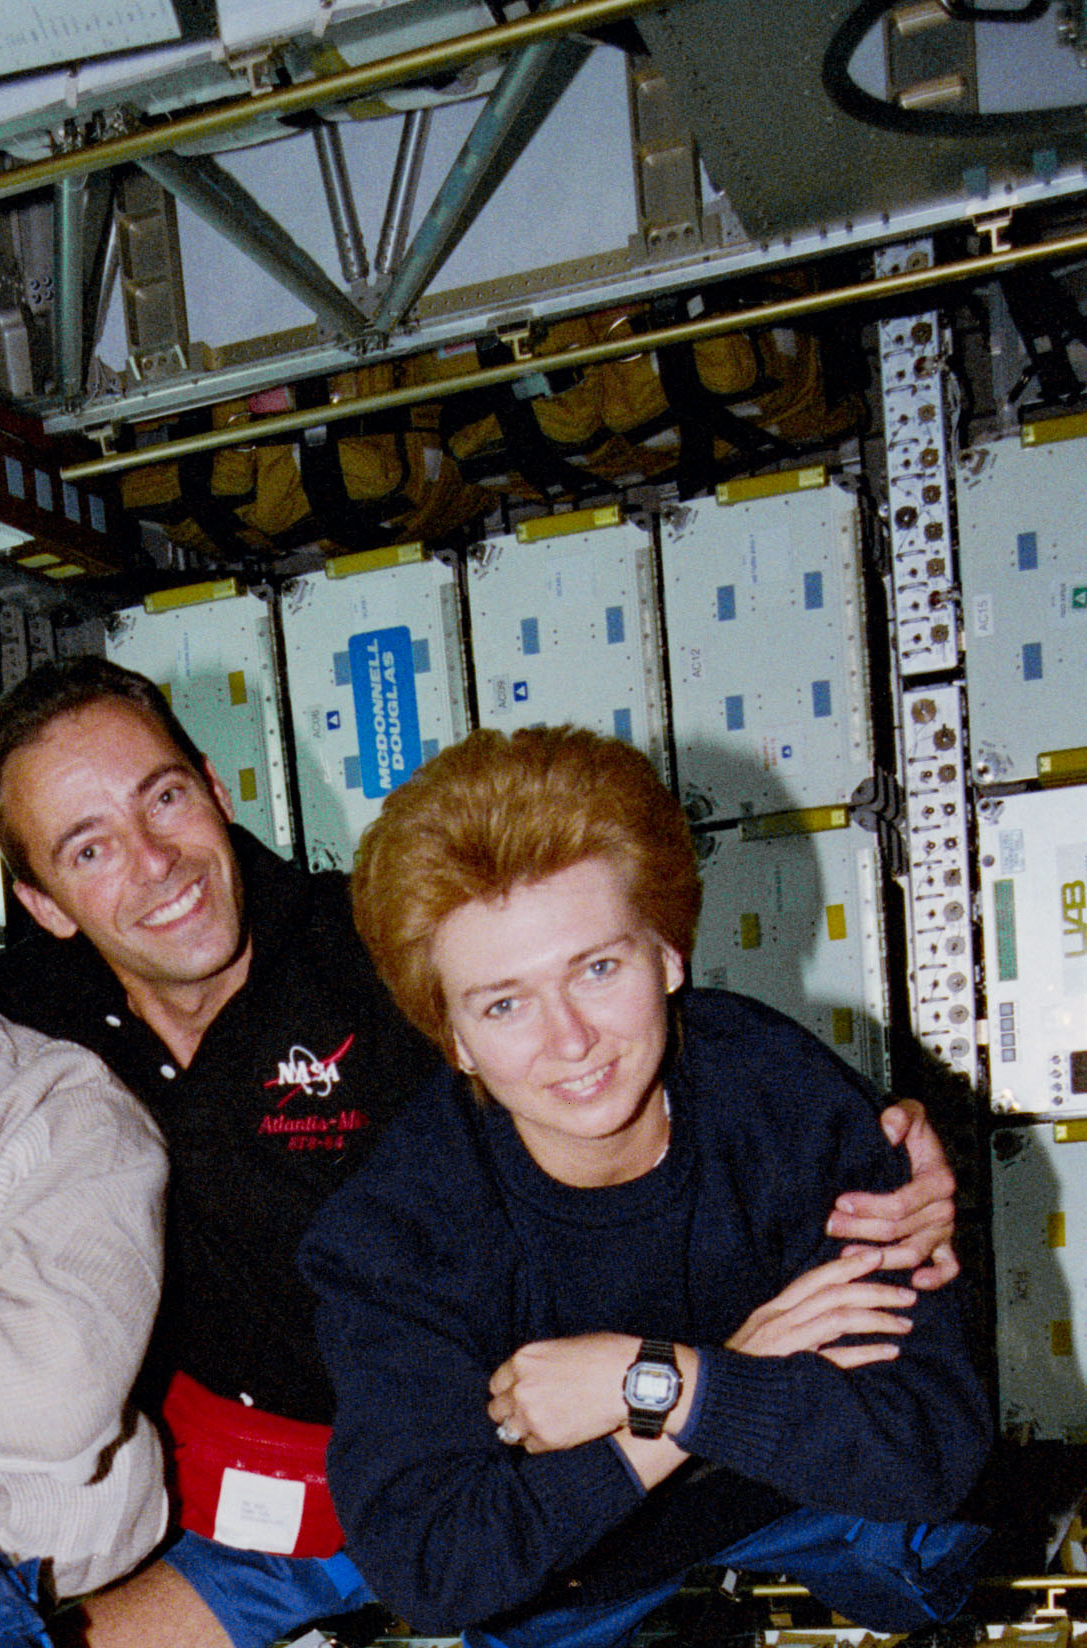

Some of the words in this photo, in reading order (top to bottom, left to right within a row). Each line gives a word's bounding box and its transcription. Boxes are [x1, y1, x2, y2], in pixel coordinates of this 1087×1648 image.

[691, 648, 702, 678] AC12
[367, 638, 392, 789] MCDONNELL
[382, 651, 405, 771] DOUGLAS
[277, 1060, 341, 1086] NASA
